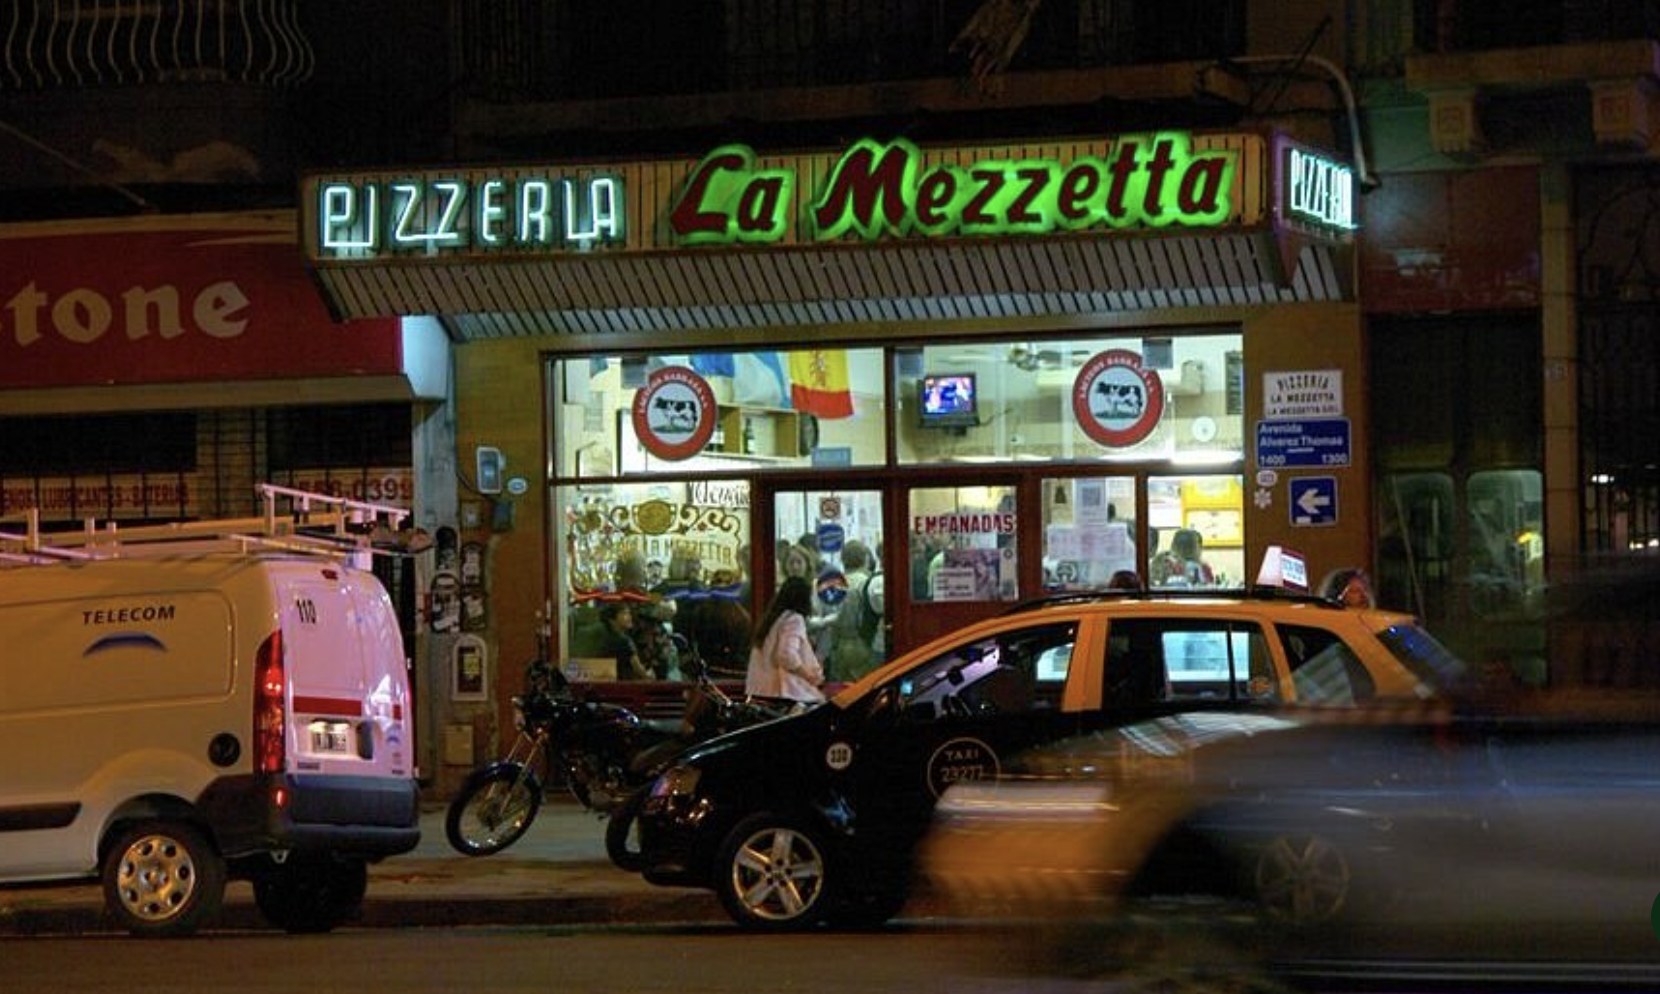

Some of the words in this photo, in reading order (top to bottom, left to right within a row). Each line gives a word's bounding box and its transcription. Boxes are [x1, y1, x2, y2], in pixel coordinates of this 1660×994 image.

[671, 153, 783, 236] La
[815, 140, 1226, 229] Mezzetta
[320, 177, 617, 249] PIZZERIA
[0, 280, 250, 347] tone
[1260, 423, 1303, 434] Avenida
[1301, 434, 1343, 446] Thomas
[1260, 455, 1286, 465] 1400
[1322, 453, 1348, 464] 1300
[915, 515, 1014, 535] EMPANADAS
[83, 605, 176, 625] TELECOM
